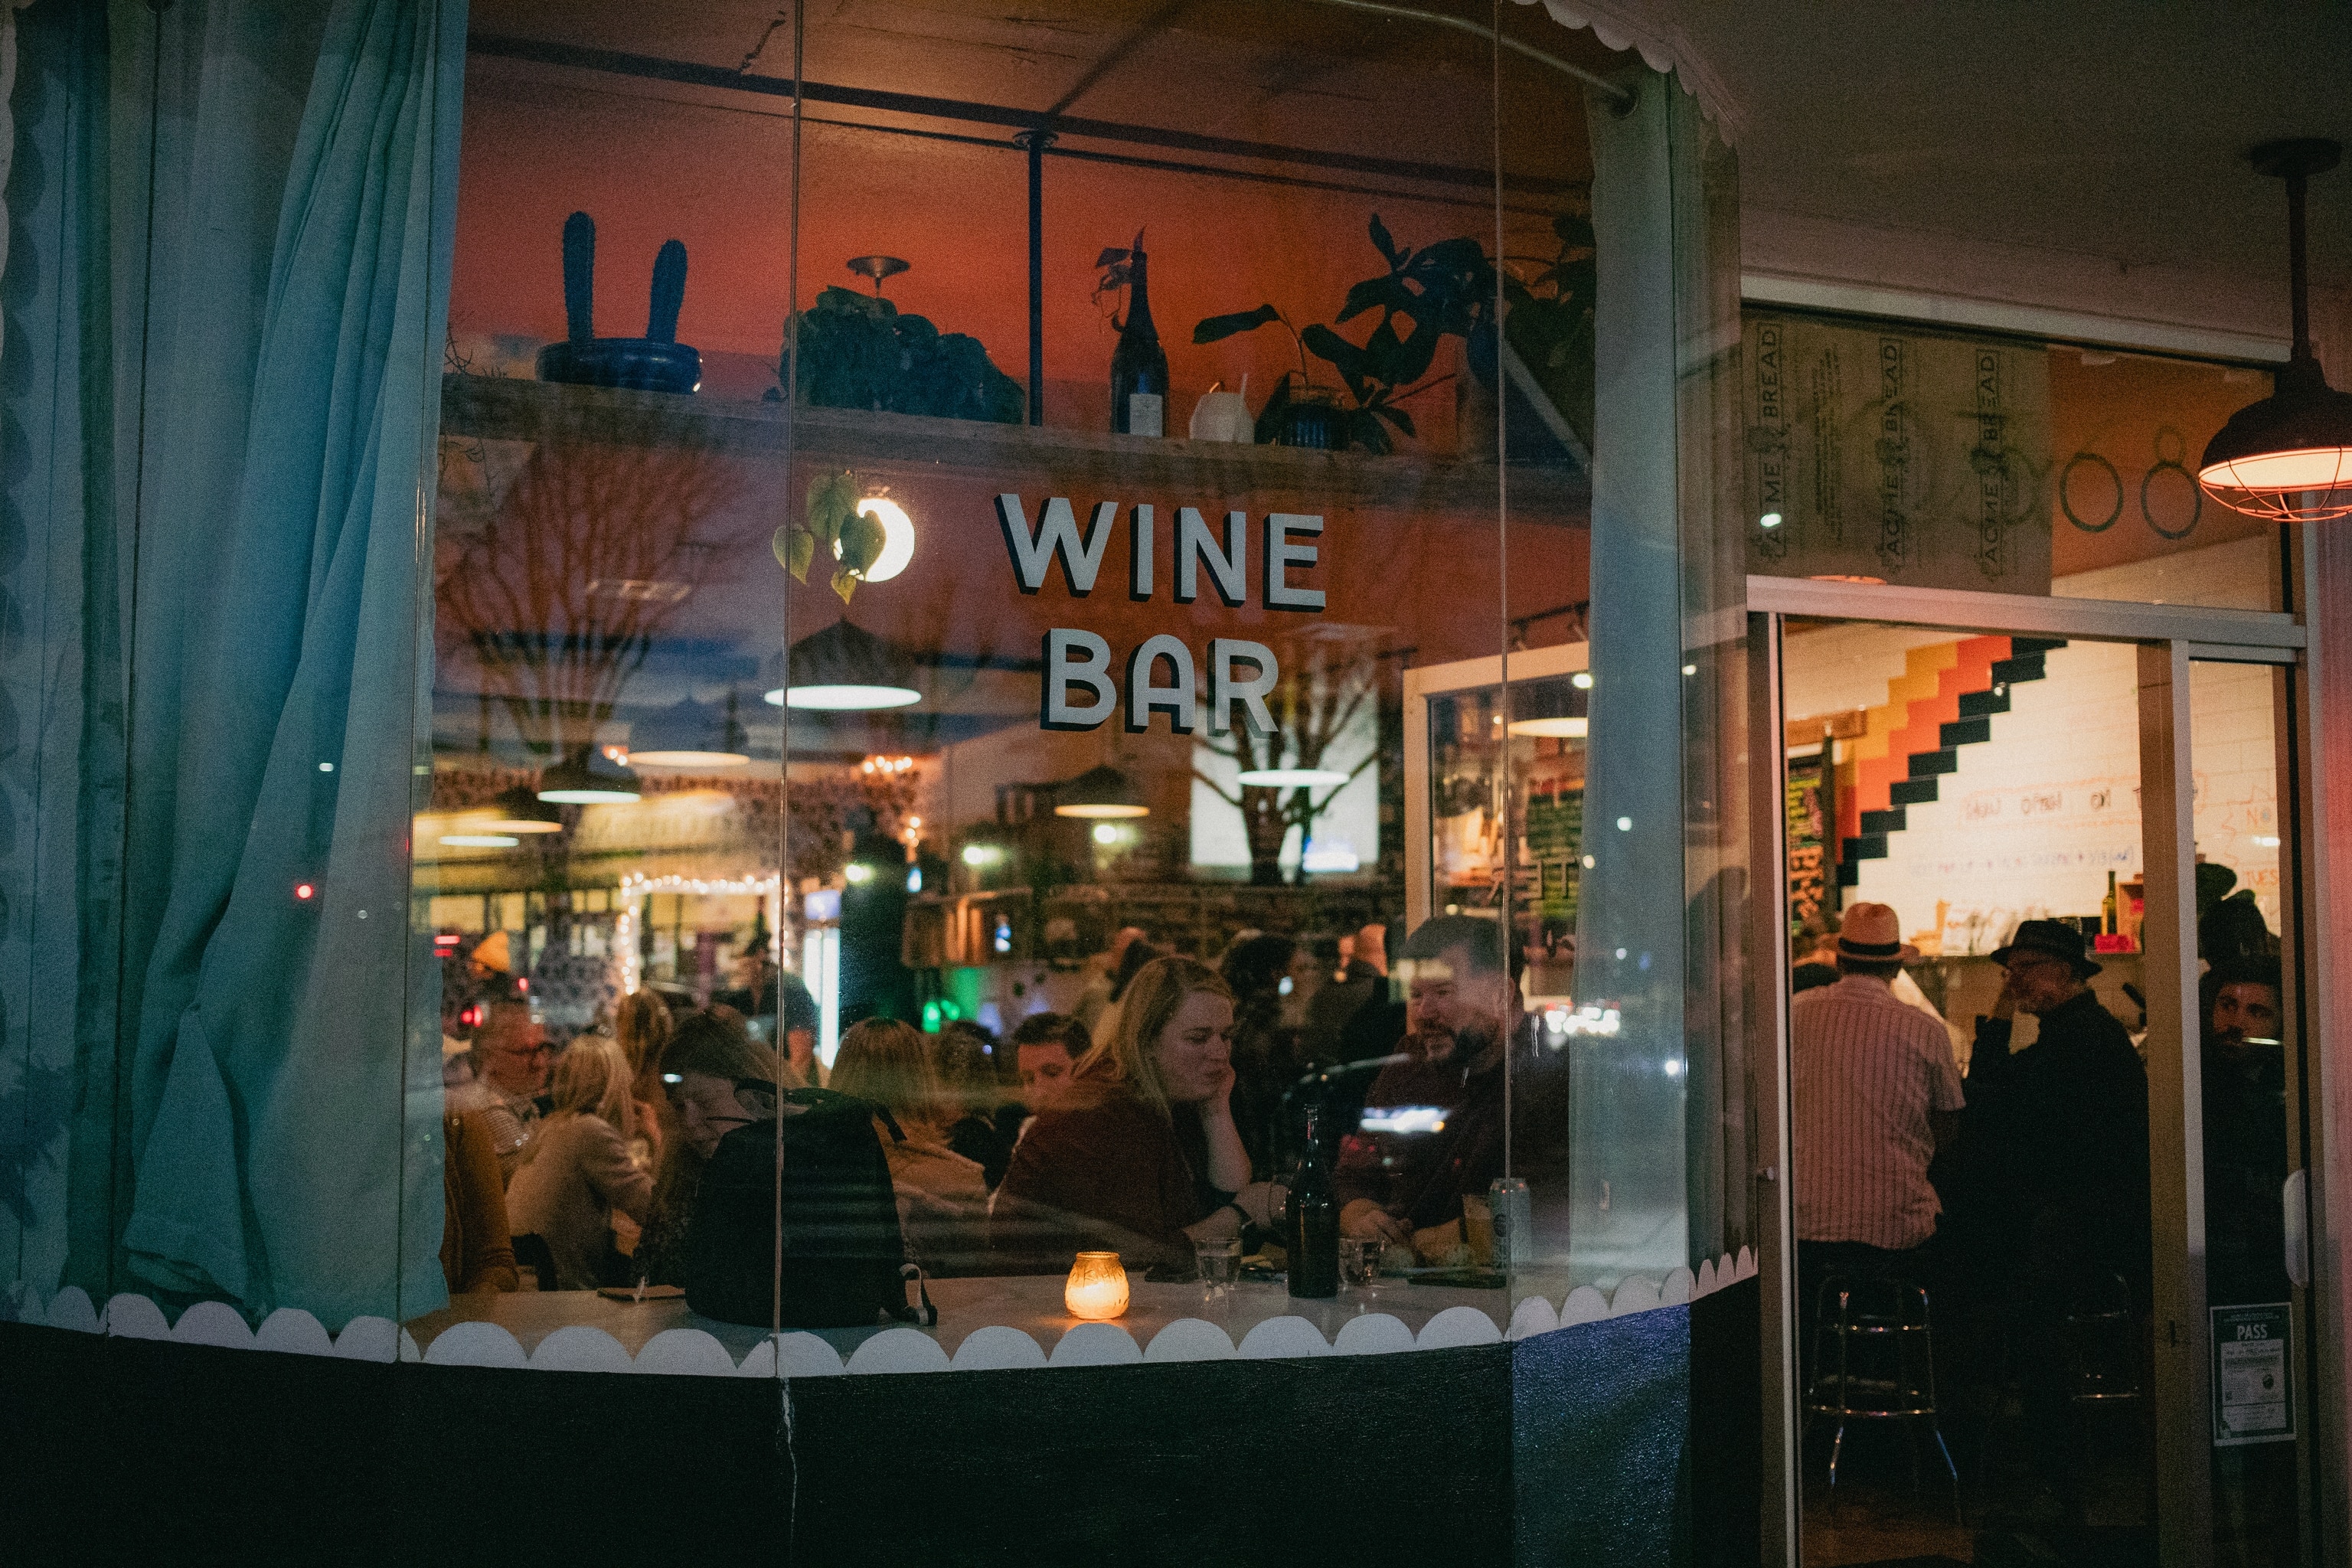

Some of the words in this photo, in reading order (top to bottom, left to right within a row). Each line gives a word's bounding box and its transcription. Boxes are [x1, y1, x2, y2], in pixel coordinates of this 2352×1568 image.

[1760, 329, 1779, 419] BREAD
[1763, 462, 1782, 545] AME
[993, 493, 1326, 612] WINE
[1040, 628, 1279, 738] BAR
[2236, 1324, 2269, 1340] PASS
